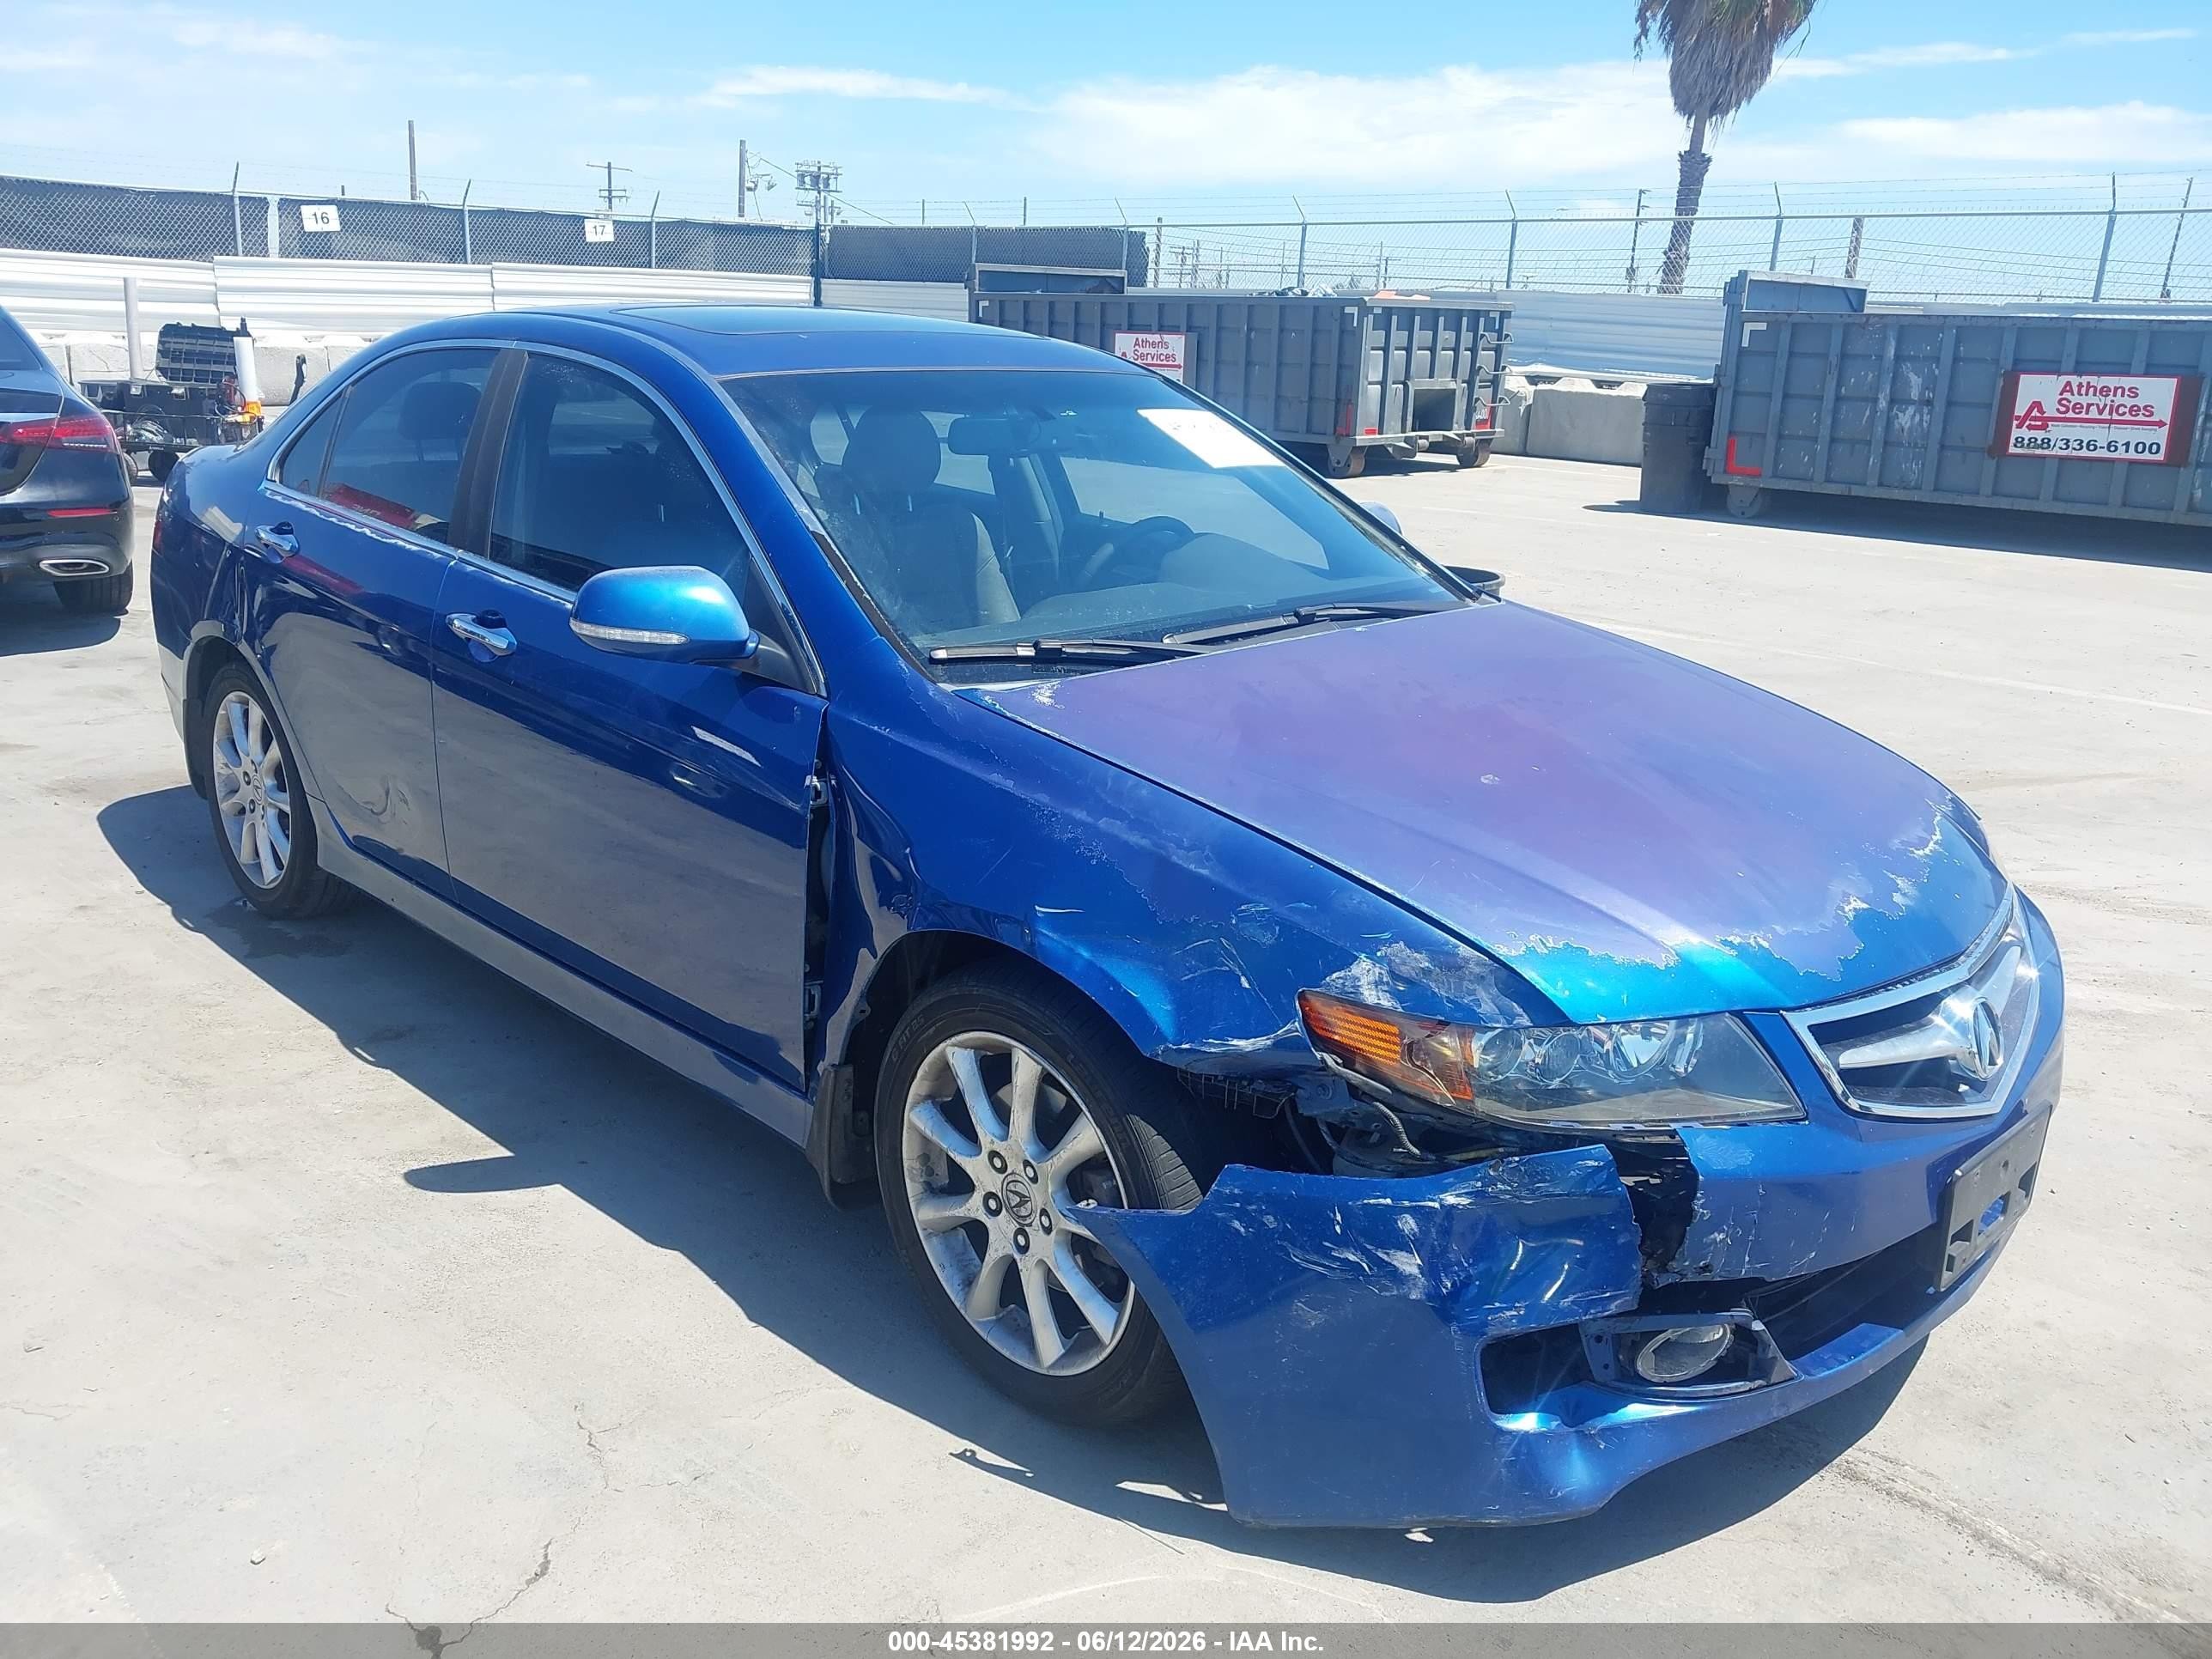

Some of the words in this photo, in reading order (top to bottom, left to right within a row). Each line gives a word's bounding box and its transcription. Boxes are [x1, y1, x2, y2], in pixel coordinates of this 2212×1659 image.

[311, 211, 330, 225] 16
[592, 224, 606, 236] 17
[1133, 337, 1170, 349] Athens
[1133, 349, 1177, 363] Services
[2058, 380, 2140, 398] Athens
[2055, 398, 2155, 418] Services
[2013, 435, 2162, 455] 888/336-6100
